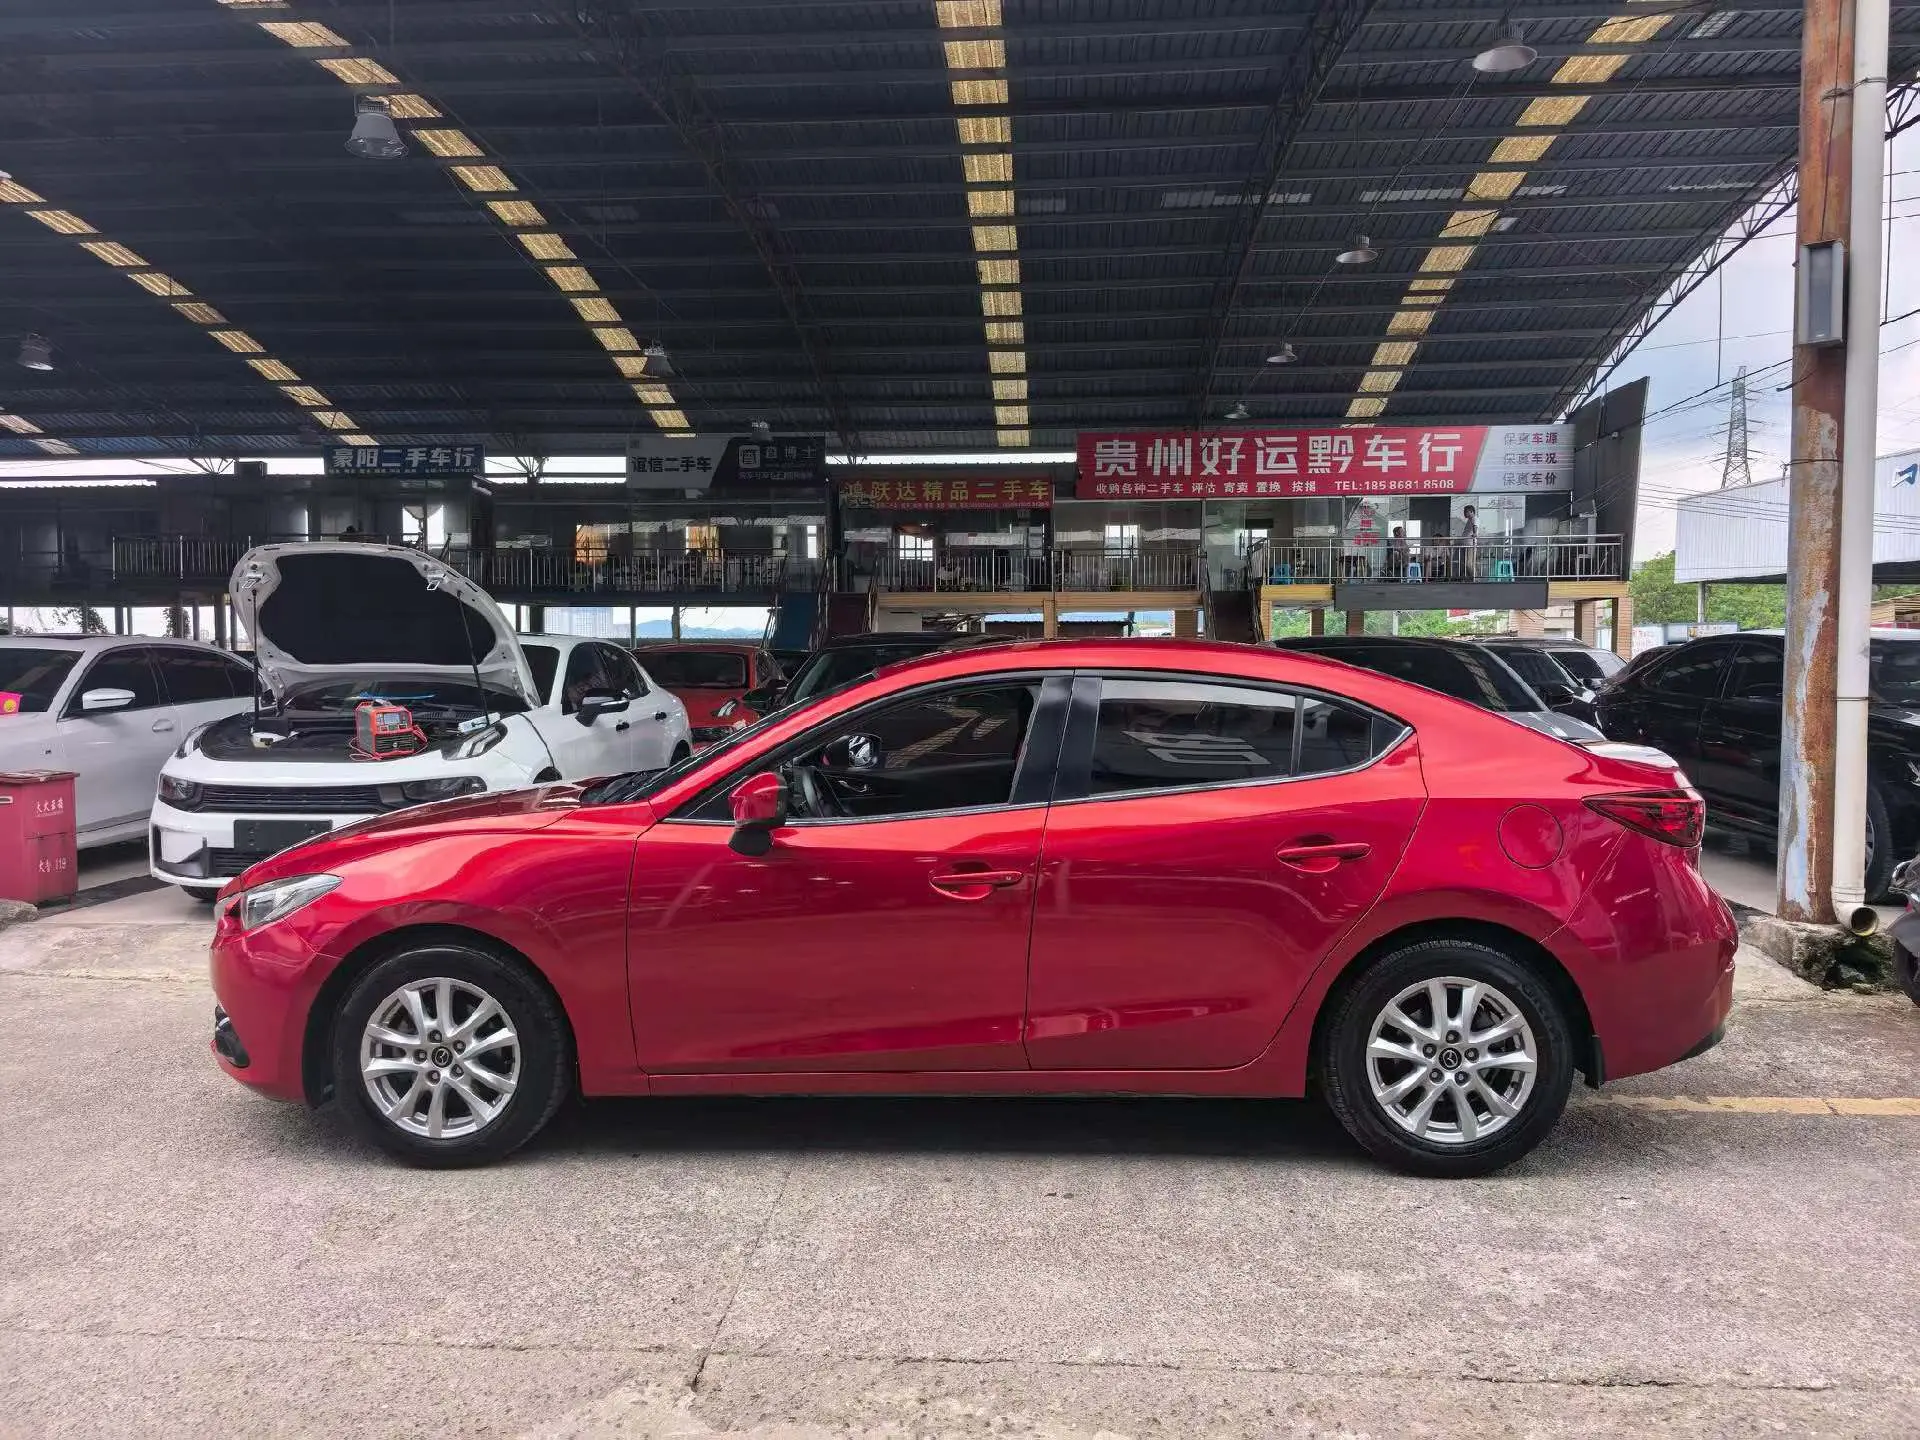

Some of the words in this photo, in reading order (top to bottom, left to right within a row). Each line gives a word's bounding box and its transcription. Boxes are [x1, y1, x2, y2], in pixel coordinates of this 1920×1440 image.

[1504, 432, 1558, 445] 保真车源
[1094, 432, 1463, 476] 贵州好运黔车行
[1504, 453, 1558, 465] 保真车况
[1503, 472, 1557, 486] 保真车价
[1096, 482, 1184, 494] 收购各种二手车
[1191, 481, 1217, 494] 评估
[1223, 481, 1249, 493] 寄卖
[1256, 481, 1281, 493] 置换
[1292, 480, 1316, 493] 按揭
